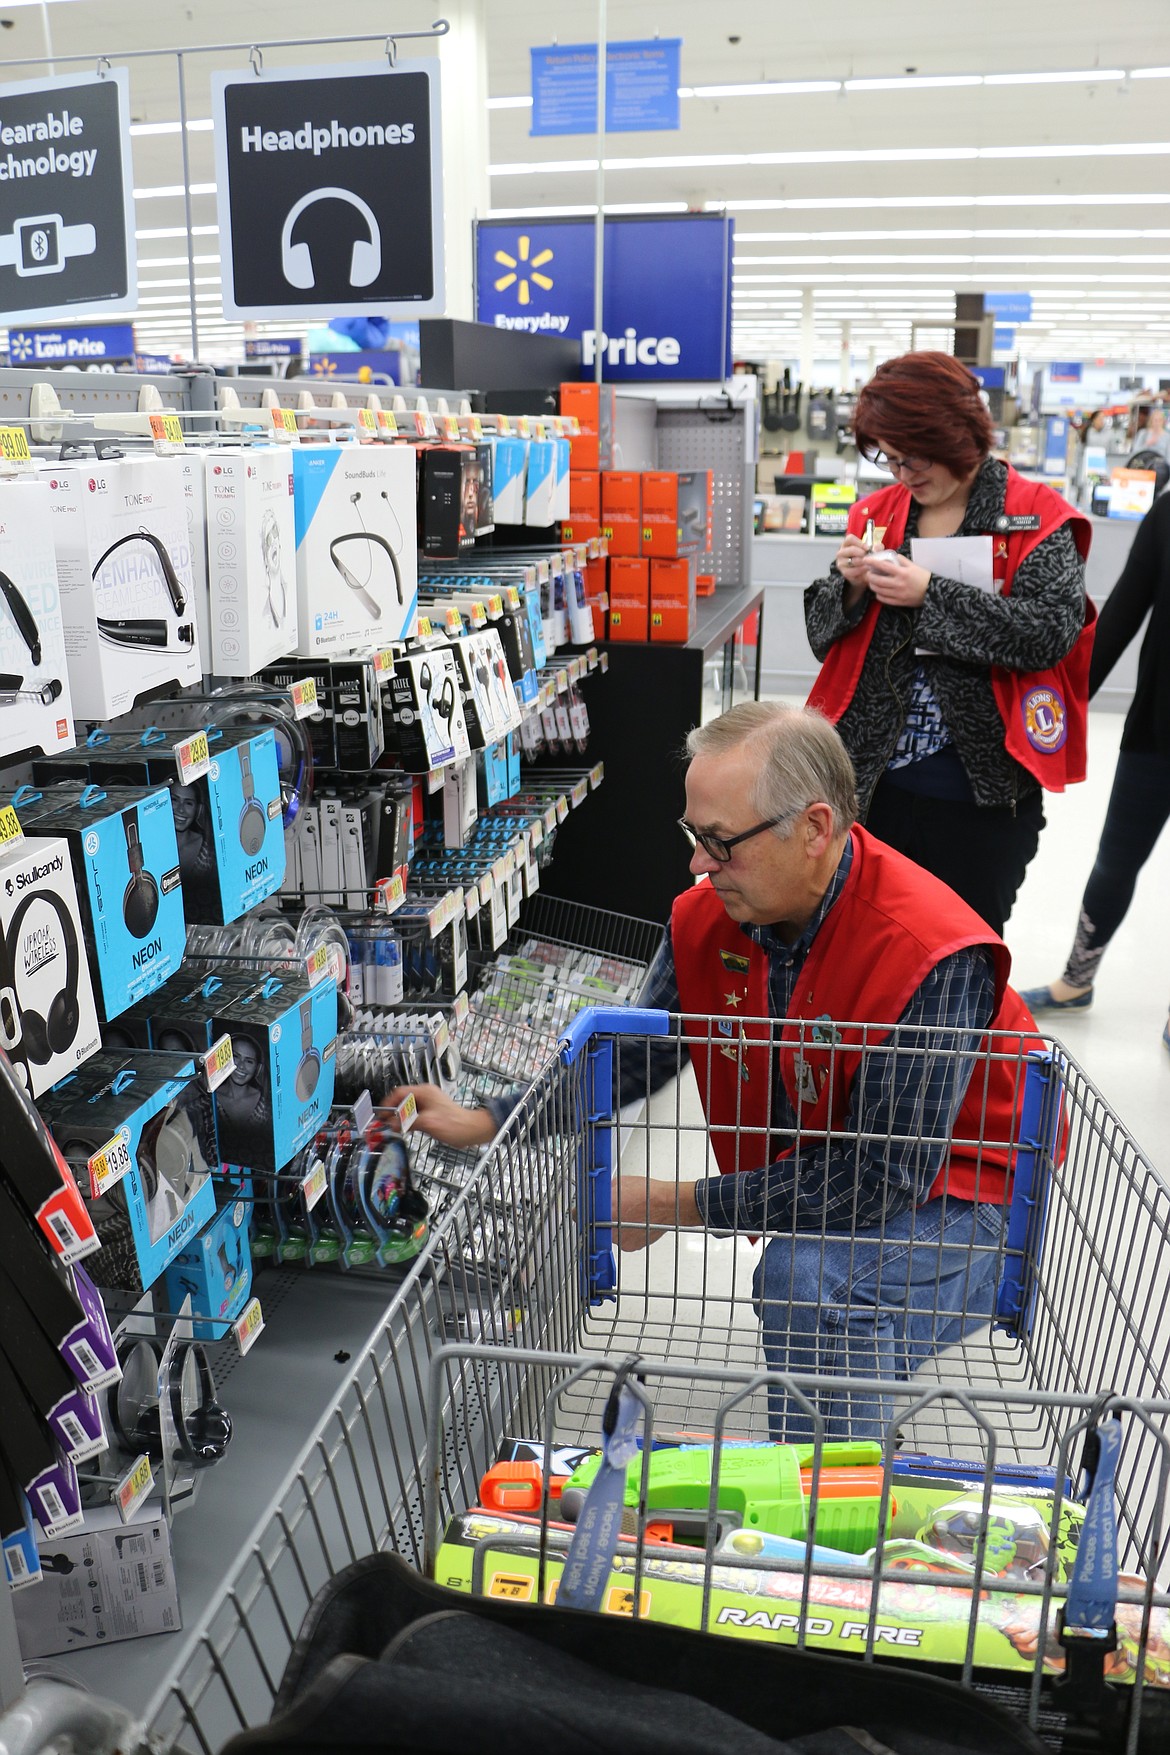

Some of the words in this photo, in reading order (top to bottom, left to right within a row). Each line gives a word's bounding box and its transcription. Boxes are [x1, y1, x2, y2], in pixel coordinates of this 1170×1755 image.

[0, 110, 84, 146] earable
[241, 120, 416, 156] Headphones
[494, 312, 570, 334] Everyday
[36, 341, 67, 359] Low
[67, 338, 106, 356] Price
[582, 327, 681, 366] Price
[97, 479, 106, 489] LG
[345, 470, 376, 480] SoundBuds
[124, 494, 144, 507] TONE
[143, 495, 153, 504] PRO
[214, 486, 235, 494] TONE
[101, 545, 189, 589] ENHANED
[324, 611, 338, 621] 24H
[392, 678, 411, 689] ALTEC
[1028, 693, 1052, 709] LIONS
[1036, 708, 1054, 732] L
[15, 854, 64, 890] Skullcandy
[244, 857, 269, 884] NEON
[23, 923, 51, 953] UPROAR
[23, 939, 57, 969] WIRELESS
[132, 936, 162, 970] NEON
[81, 1039, 98, 1057] Bluetooth
[298, 1098, 319, 1125] NEON
[168, 1210, 195, 1248] NEON
[70, 1241, 96, 1258] Bluetooth
[93, 1372, 119, 1388] Bluetooth
[79, 1442, 104, 1458] Bluetooth
[55, 1518, 80, 1532] Bluetooth
[583, 1506, 598, 1530] use
[579, 1531, 592, 1561] seat
[1101, 1517, 1114, 1550] seat
[569, 1562, 585, 1591] belts
[585, 1553, 608, 1597] Always
[1101, 1552, 1114, 1580] use
[13, 1575, 39, 1588] Bluetooth
[838, 1621, 924, 1647] FIRE
